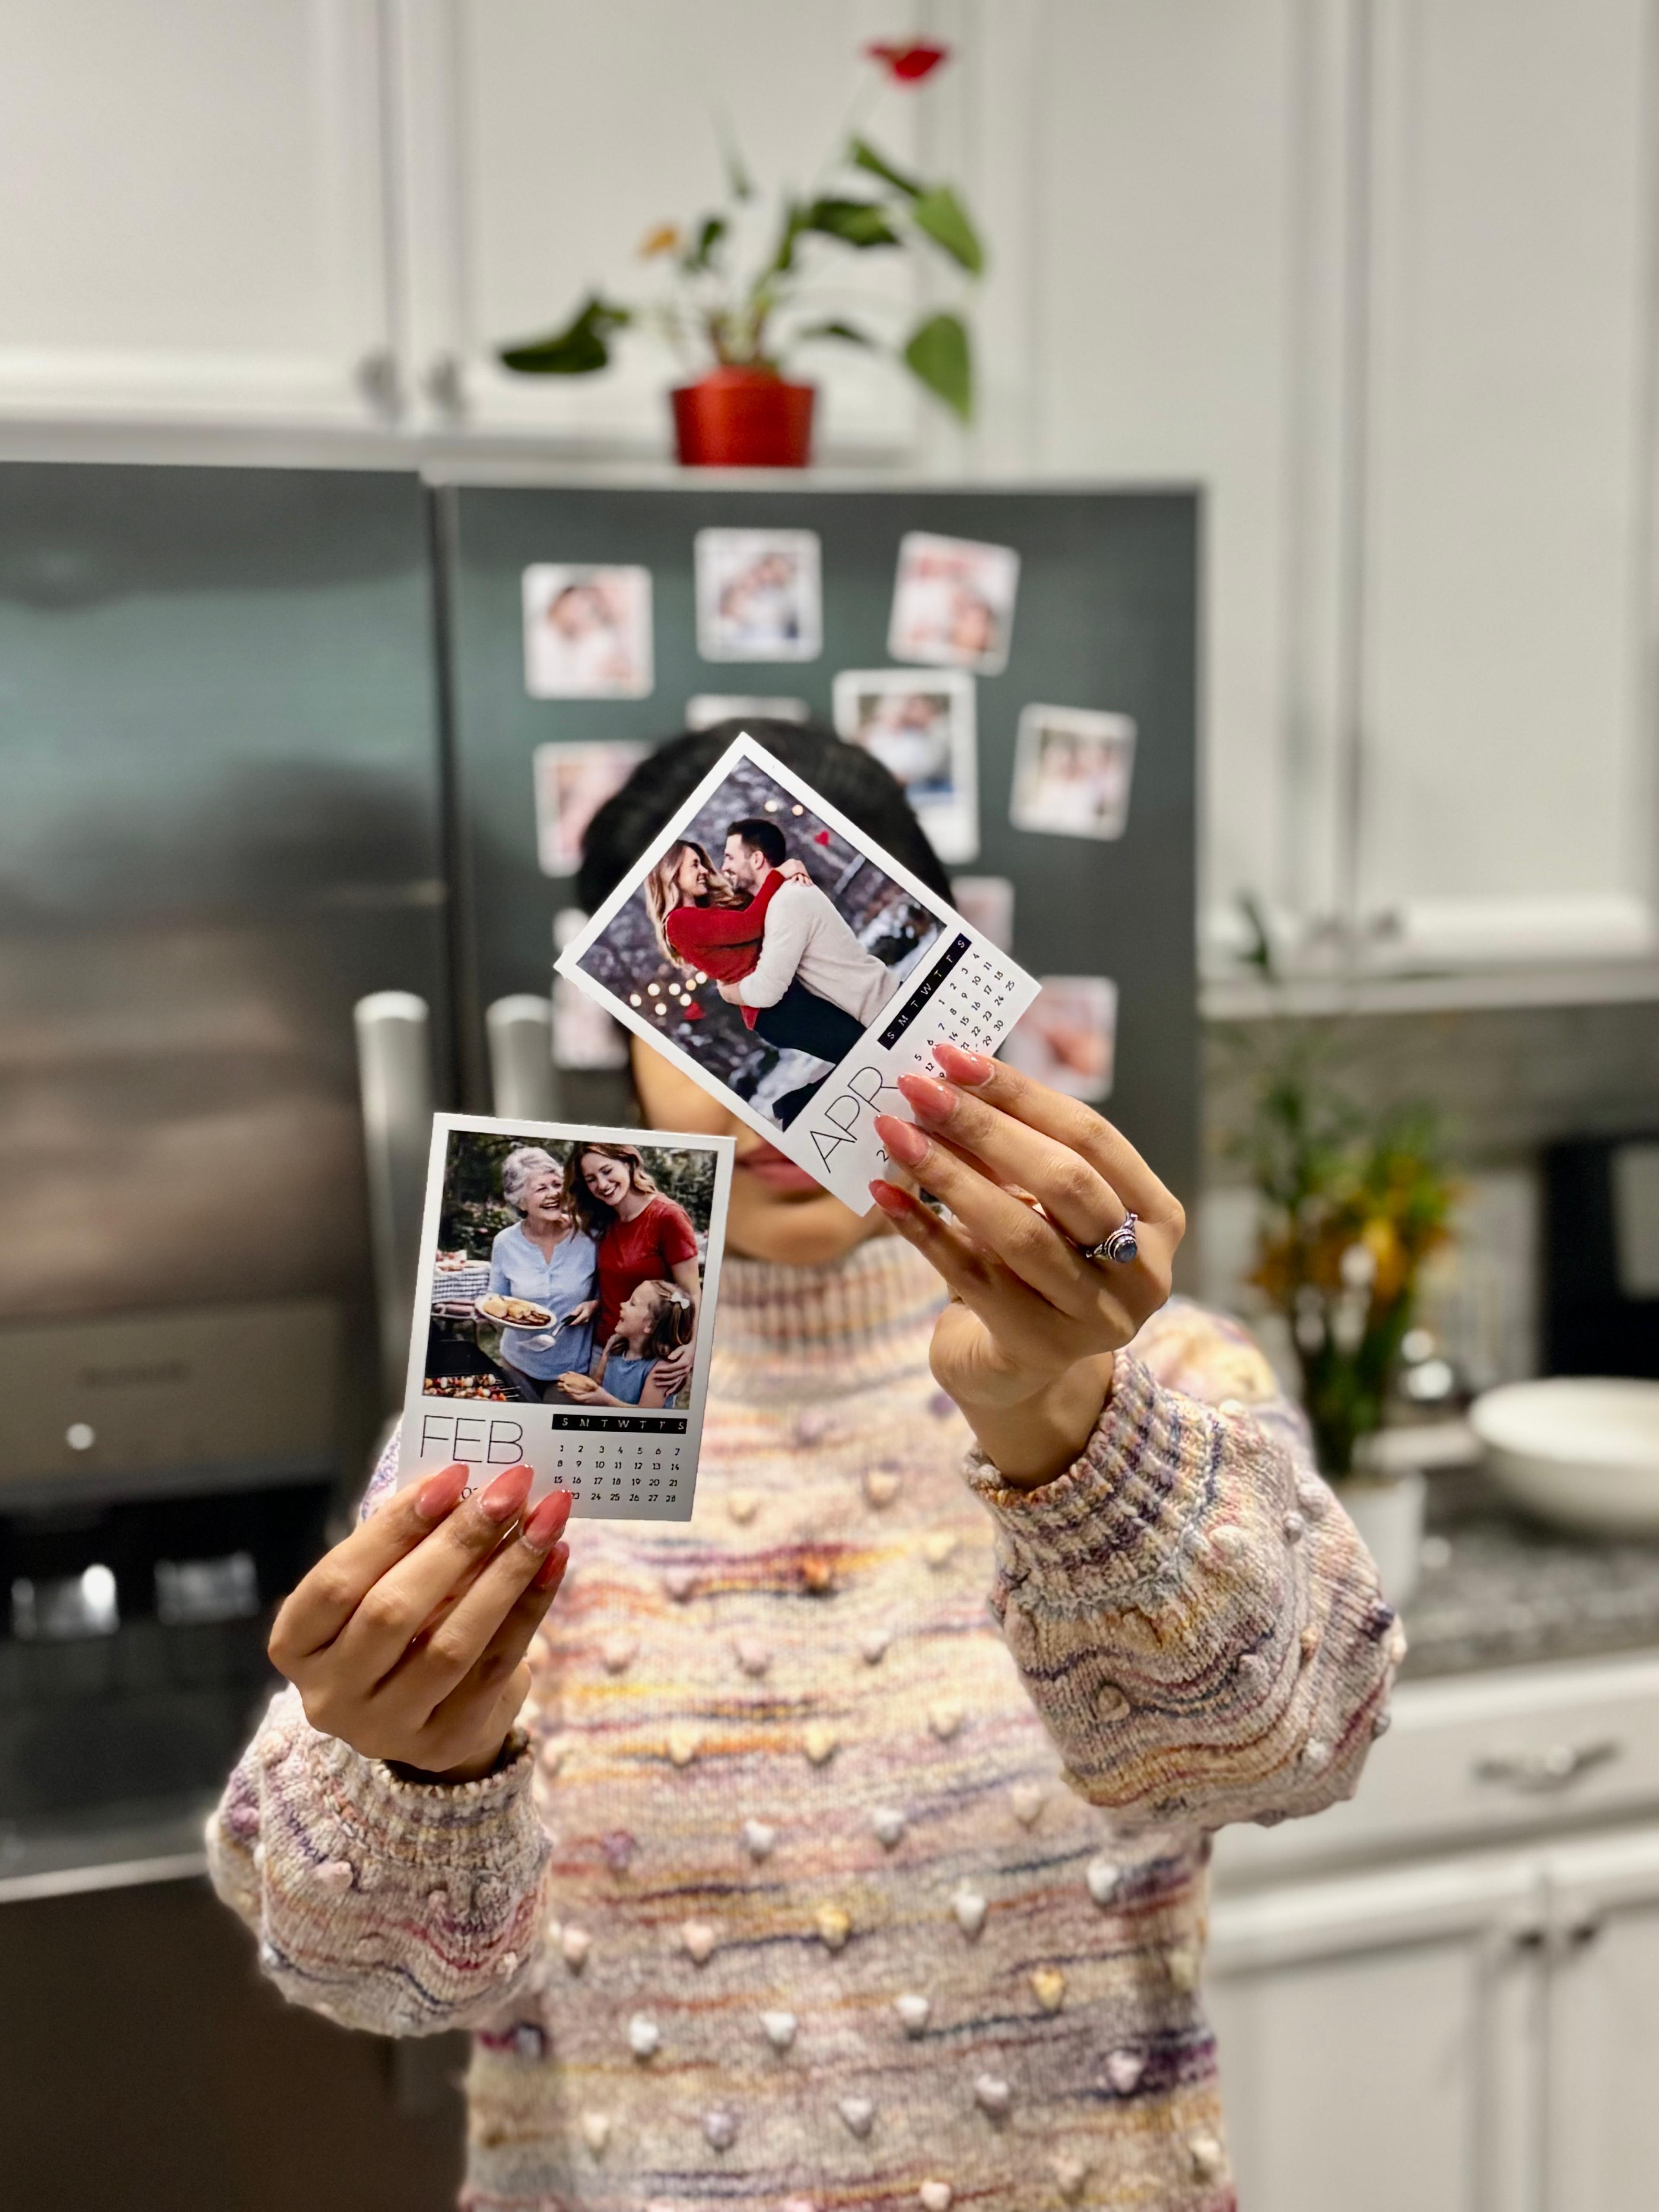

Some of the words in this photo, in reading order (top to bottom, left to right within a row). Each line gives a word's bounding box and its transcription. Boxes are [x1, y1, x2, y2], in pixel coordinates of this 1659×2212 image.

[898, 1015, 909, 1026] M
[920, 983, 931, 995] W
[946, 954, 953, 963] F
[957, 940, 965, 948] S
[938, 1022, 945, 1030] 7
[972, 976, 981, 985] 10
[983, 962, 992, 970] 11
[971, 1026, 981, 1037] 22
[982, 1011, 992, 1021] 23
[1005, 980, 1015, 992] 25
[948, 1031, 958, 1041] 14
[960, 1016, 969, 1026] 15
[971, 1001, 981, 1011] 16
[983, 985, 992, 995] 17
[982, 1036, 992, 1046] 29
[994, 1020, 1004, 1031] 30
[925, 1062, 934, 1071] 12
[810, 1066, 898, 1173] APR
[420, 1415, 523, 1464] FEB
[562, 1418, 569, 1426] S
[618, 1420, 629, 1428] W
[639, 1421, 647, 1429] T
[675, 1448, 680, 1456] 7
